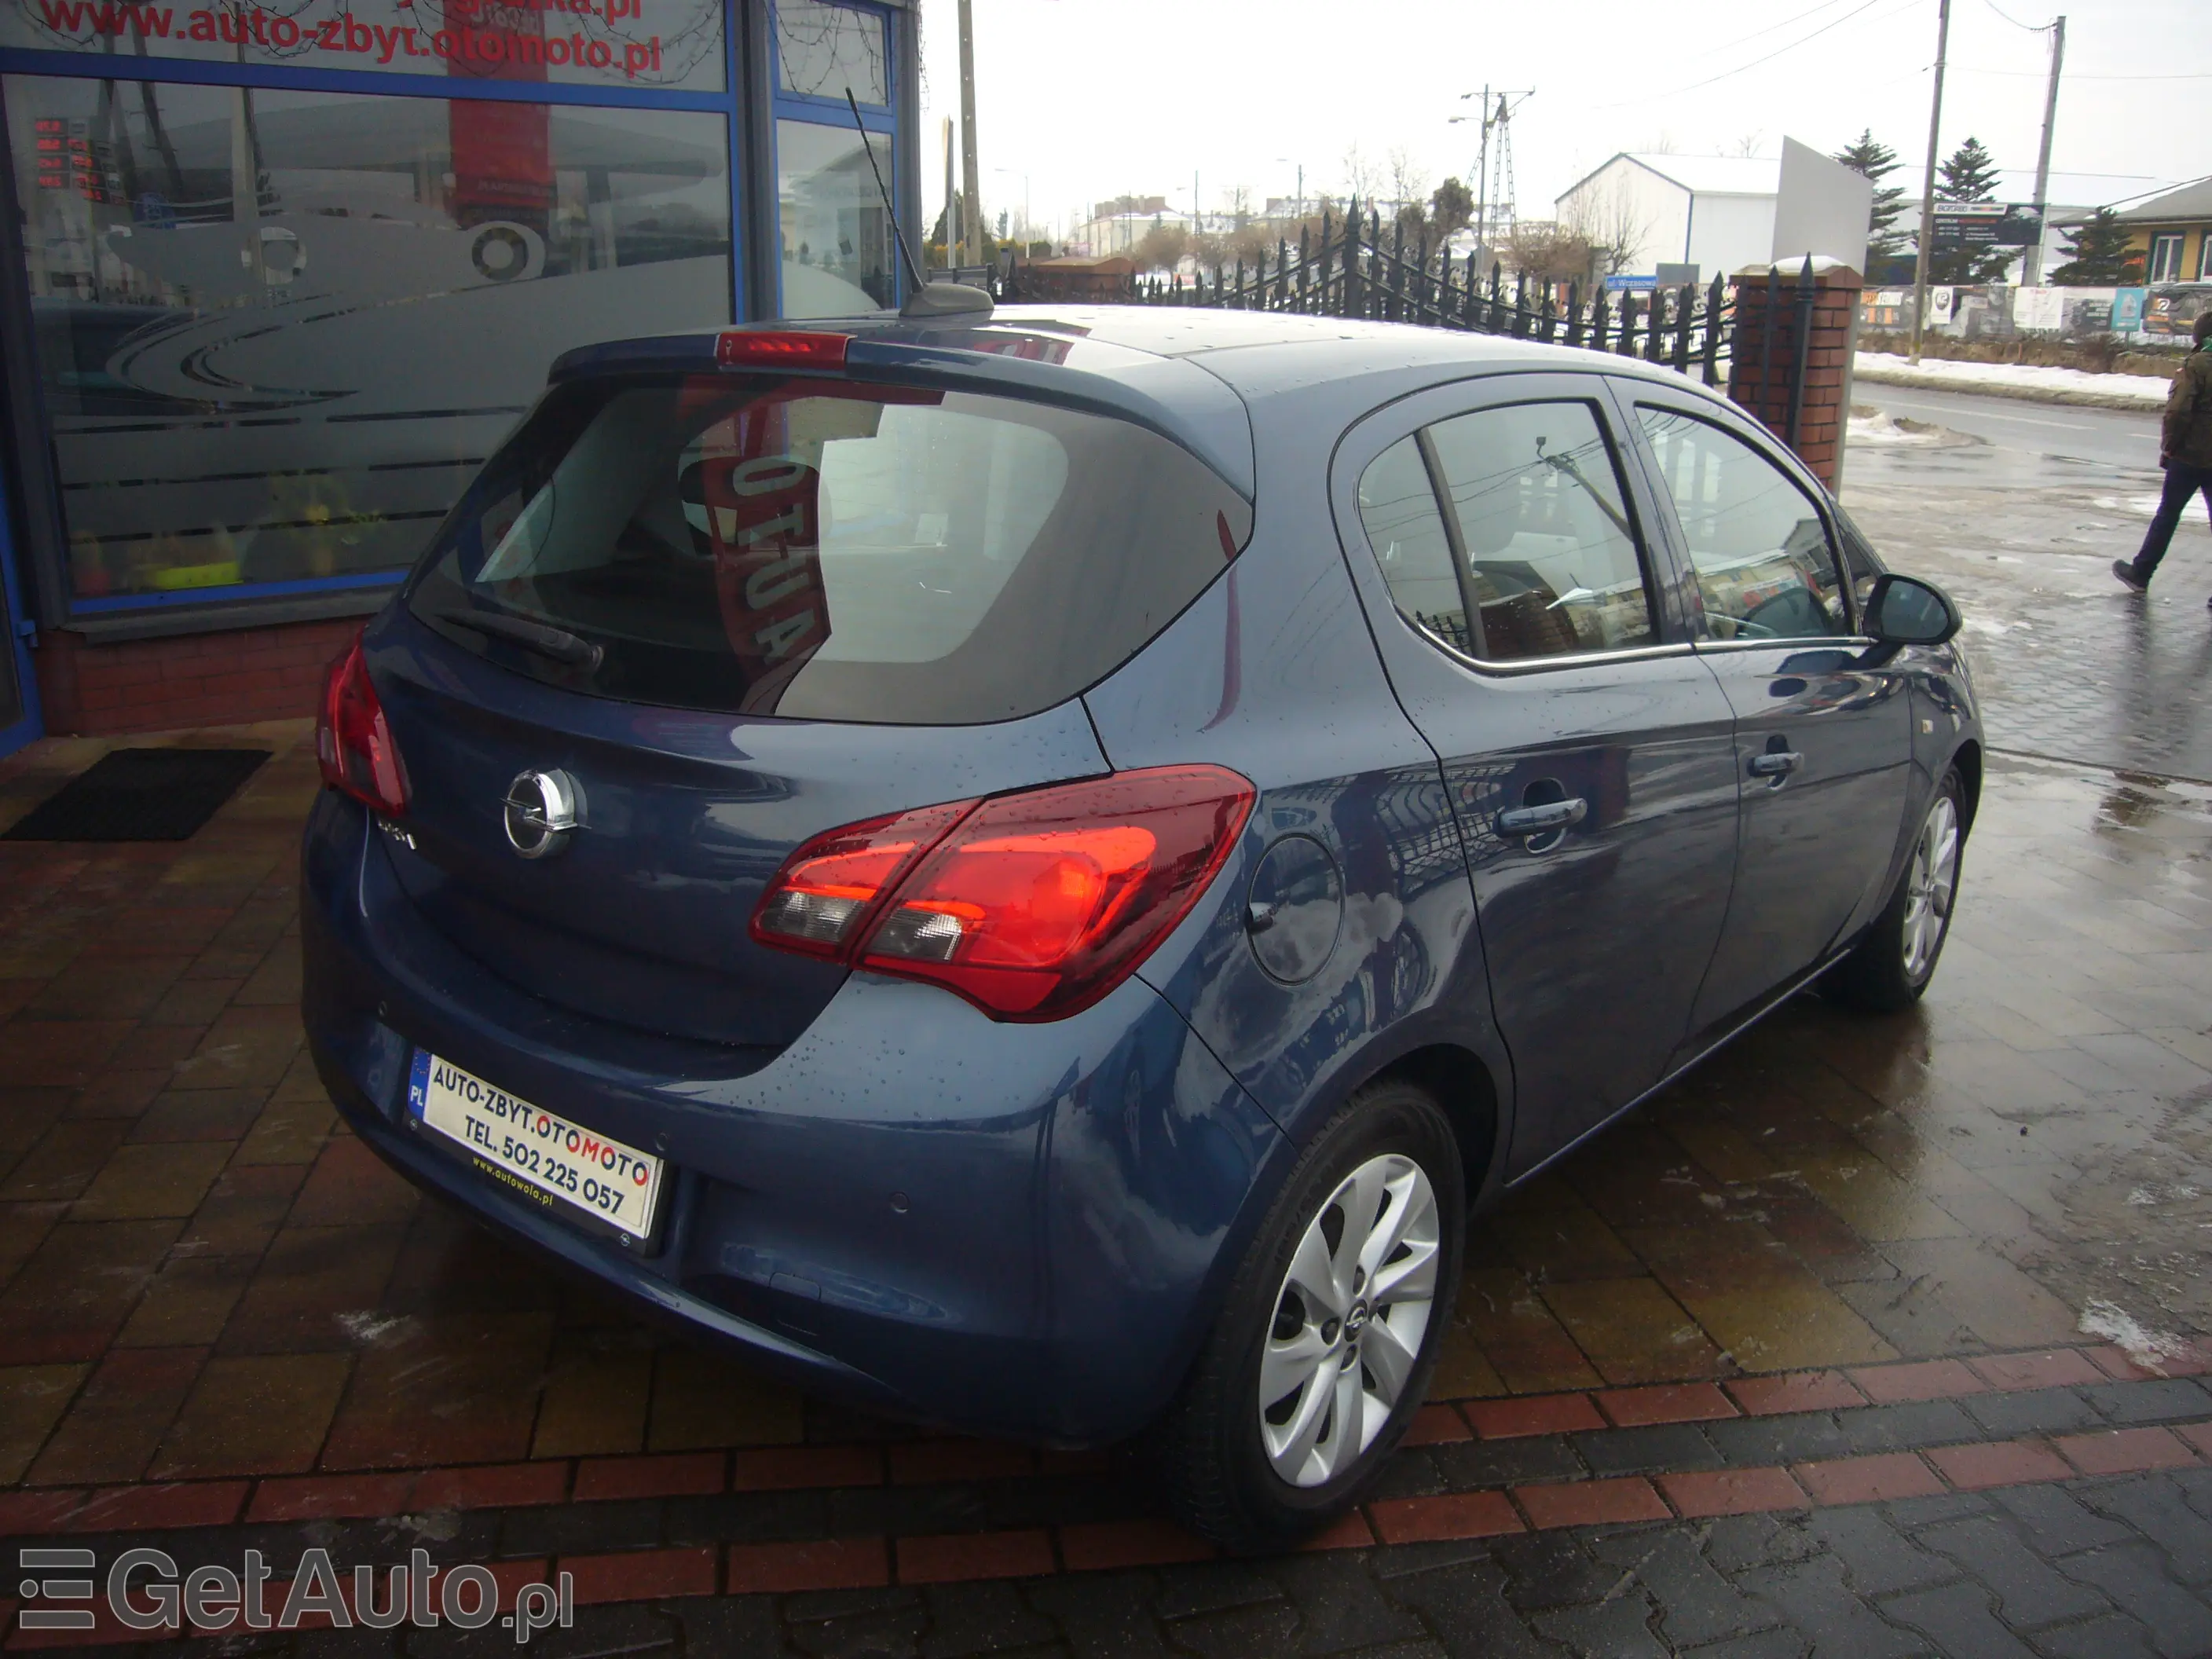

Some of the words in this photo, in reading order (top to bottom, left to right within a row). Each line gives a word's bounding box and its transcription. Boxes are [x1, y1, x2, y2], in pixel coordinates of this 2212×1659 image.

[410, 1085, 424, 1107] PL
[434, 1064, 648, 1186] AUTO-ZBYT.OTOMOTO
[465, 1114, 497, 1152] TEL.
[502, 1135, 540, 1174] 502
[543, 1157, 578, 1192] 225
[472, 1156, 554, 1207] www.autowola.pl
